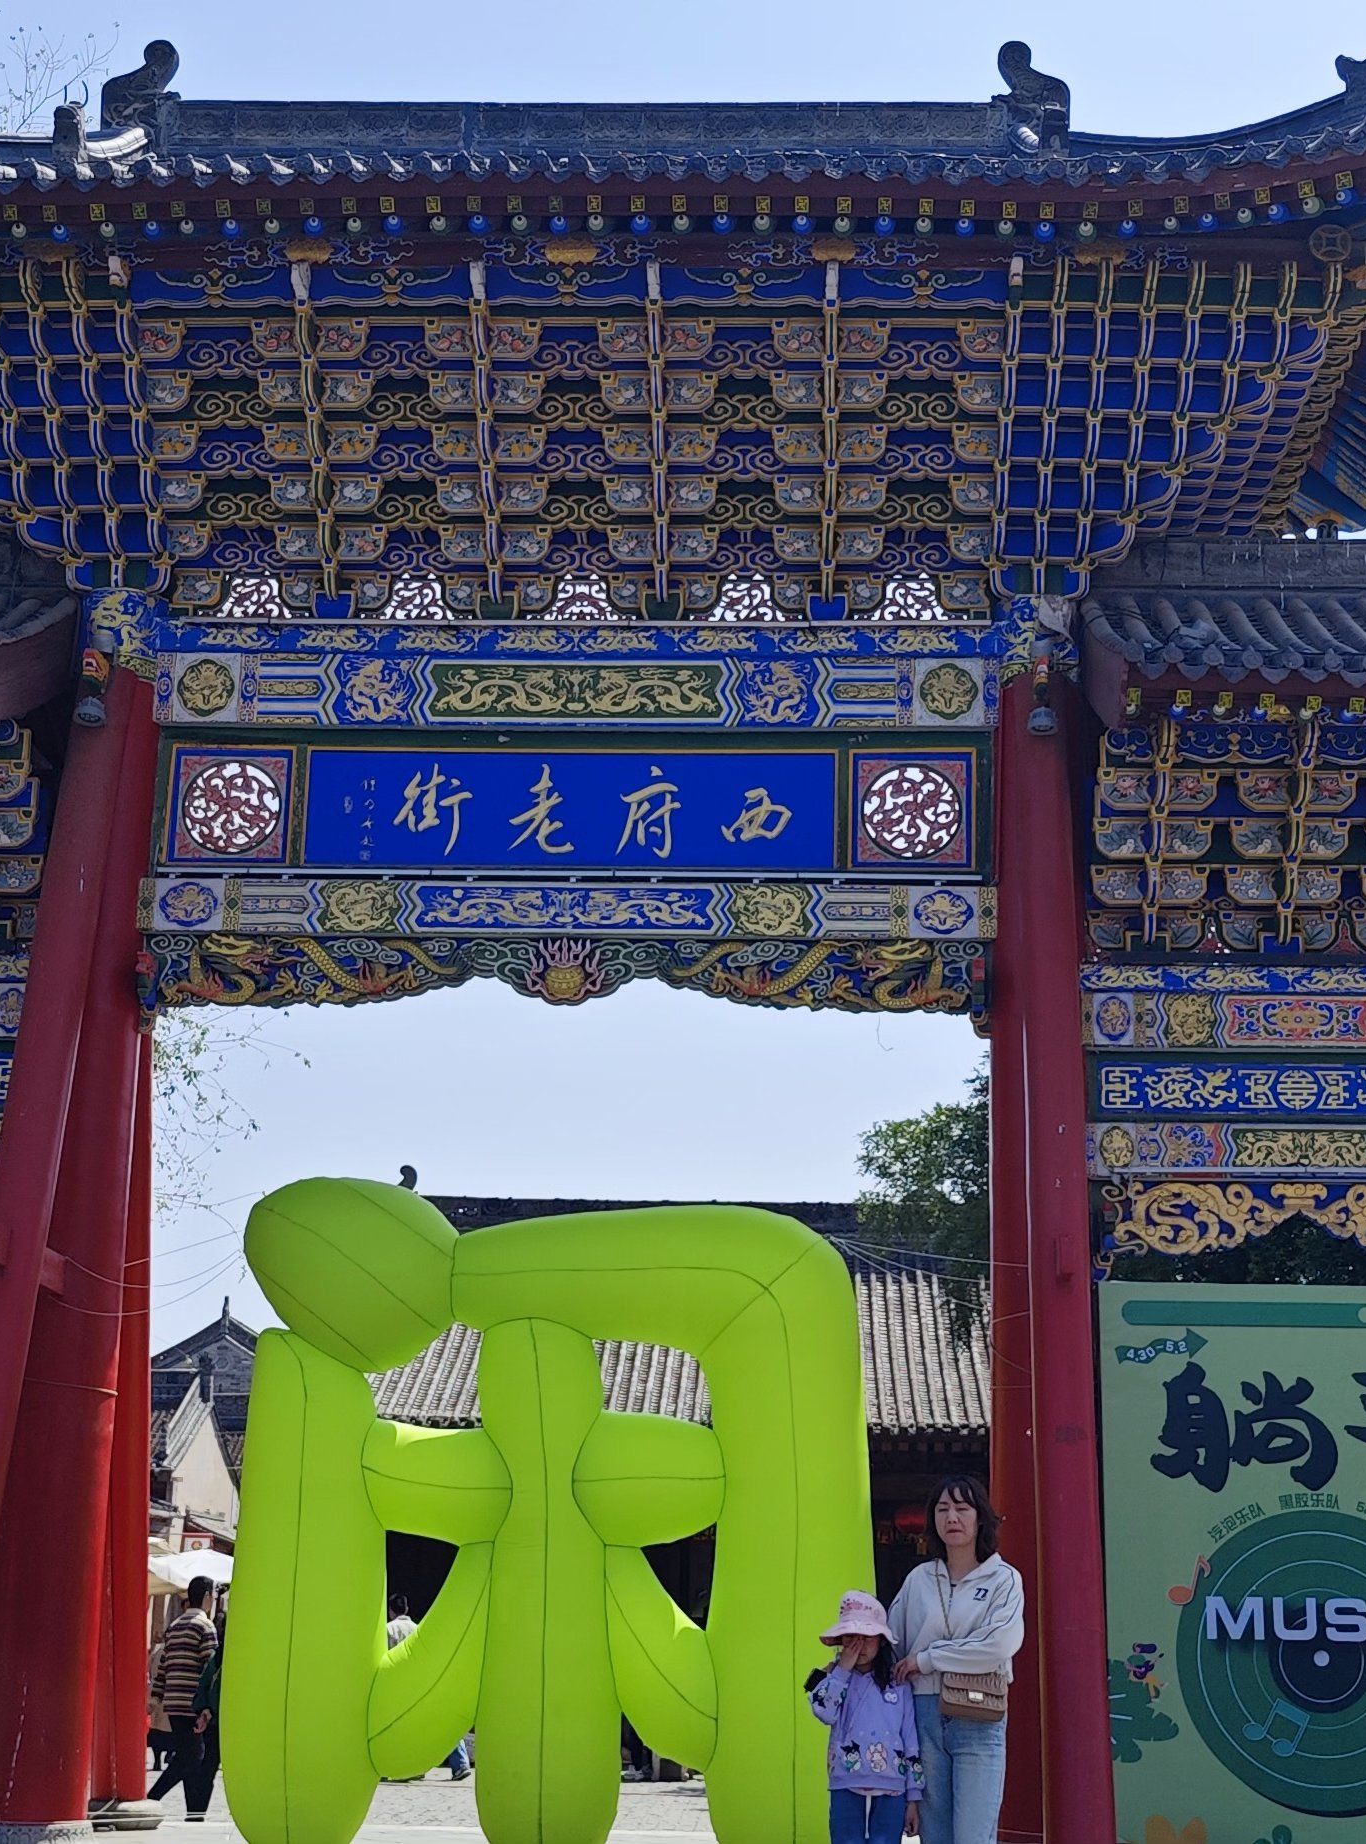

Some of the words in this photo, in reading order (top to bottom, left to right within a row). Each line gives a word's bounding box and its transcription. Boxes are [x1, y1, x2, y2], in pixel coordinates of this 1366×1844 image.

[393, 763, 793, 858] 西府老街
[1278, 1493, 1341, 1510] 黑胶乐队
